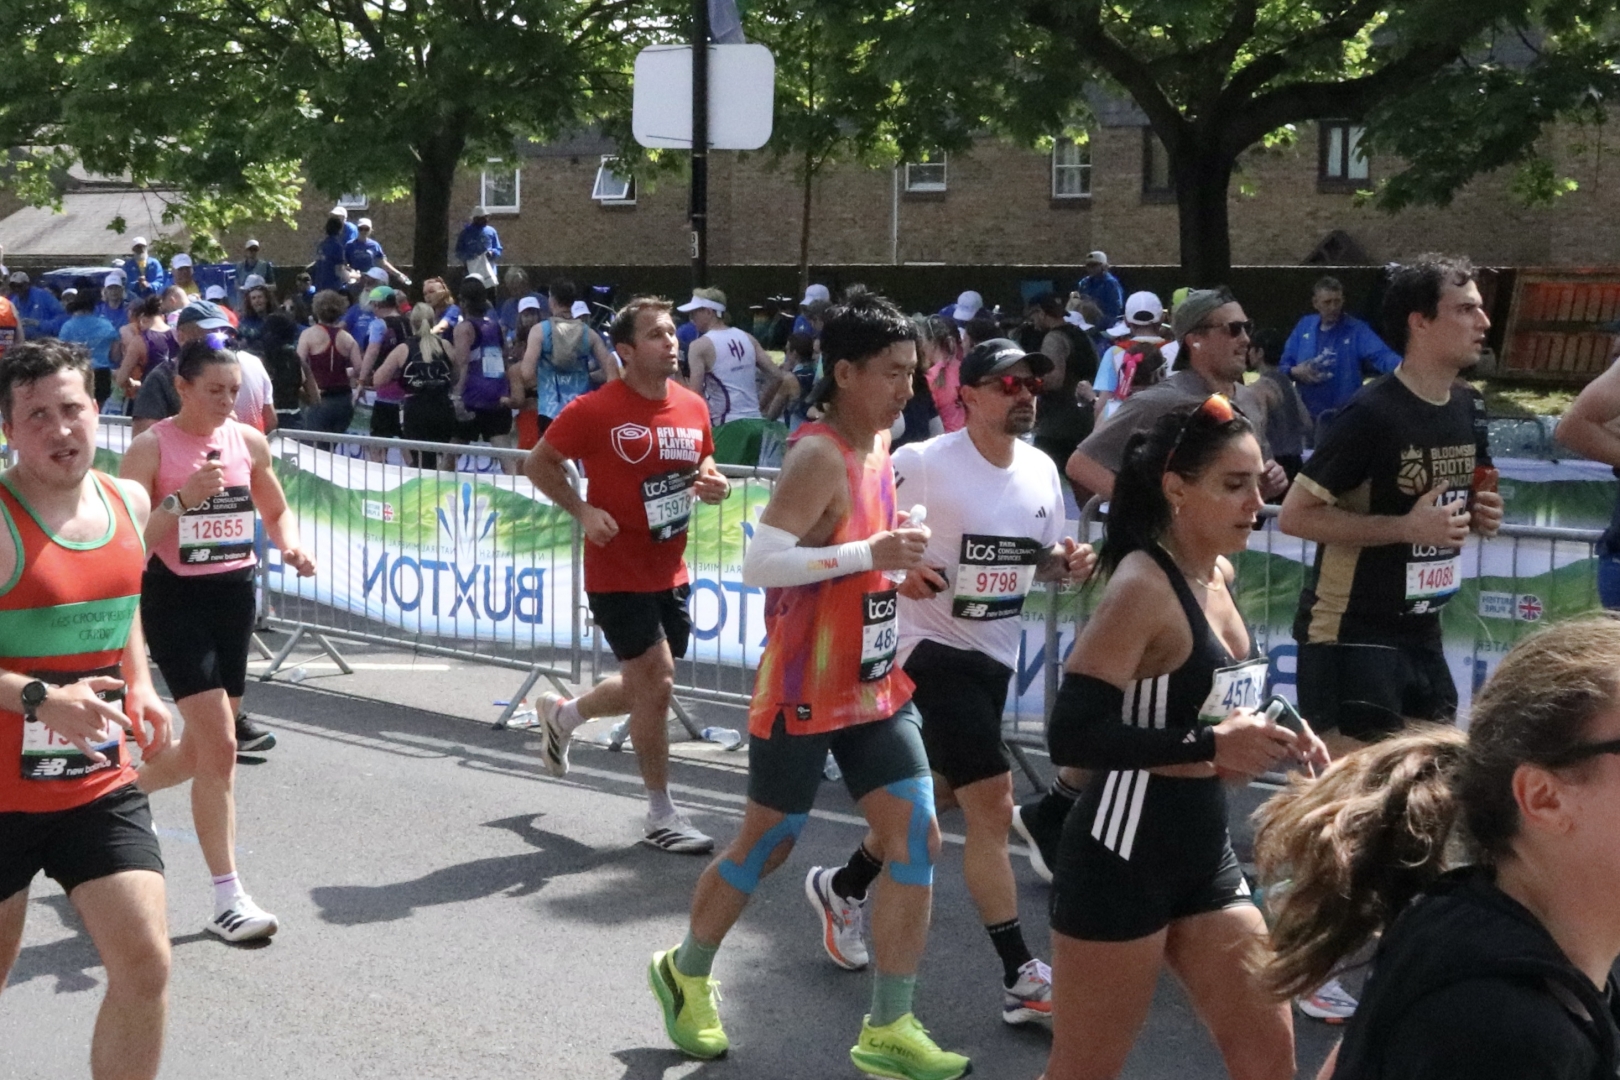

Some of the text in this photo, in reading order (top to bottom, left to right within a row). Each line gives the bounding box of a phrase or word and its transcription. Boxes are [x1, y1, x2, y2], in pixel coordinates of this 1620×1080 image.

[656, 426, 674, 438] RFU
[658, 437, 696, 450] PLAYERS
[643, 480, 668, 497] tcs
[191, 518, 243, 540] 12655
[965, 539, 996, 561] tcs
[976, 571, 1017, 593] 9798
[868, 598, 895, 620] tcs
[66, 766, 84, 776] new
